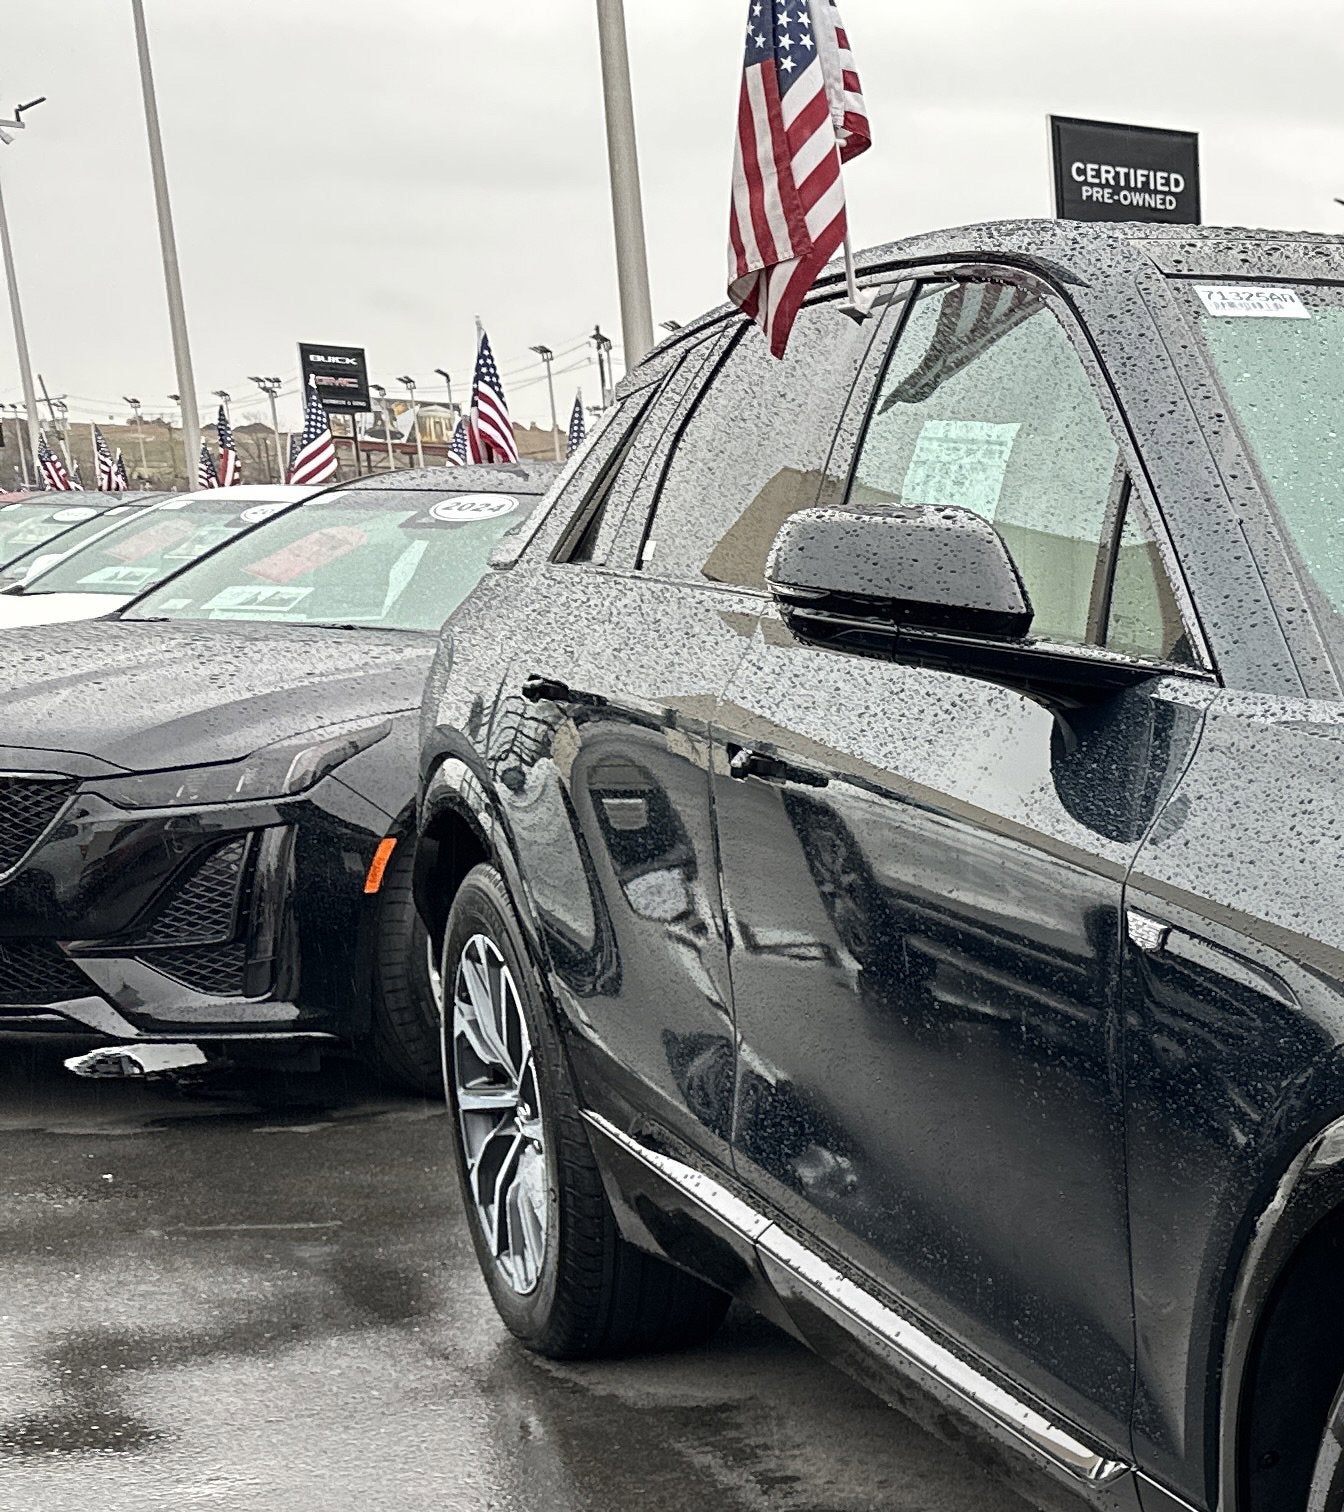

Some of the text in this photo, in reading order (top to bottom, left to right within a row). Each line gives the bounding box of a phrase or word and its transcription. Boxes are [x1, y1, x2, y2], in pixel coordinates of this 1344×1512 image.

[1071, 162, 1185, 193] CERTIFIED
[1081, 185, 1177, 210] PRE-OWNED
[309, 354, 358, 366] BUICK
[441, 501, 506, 512] 2024
